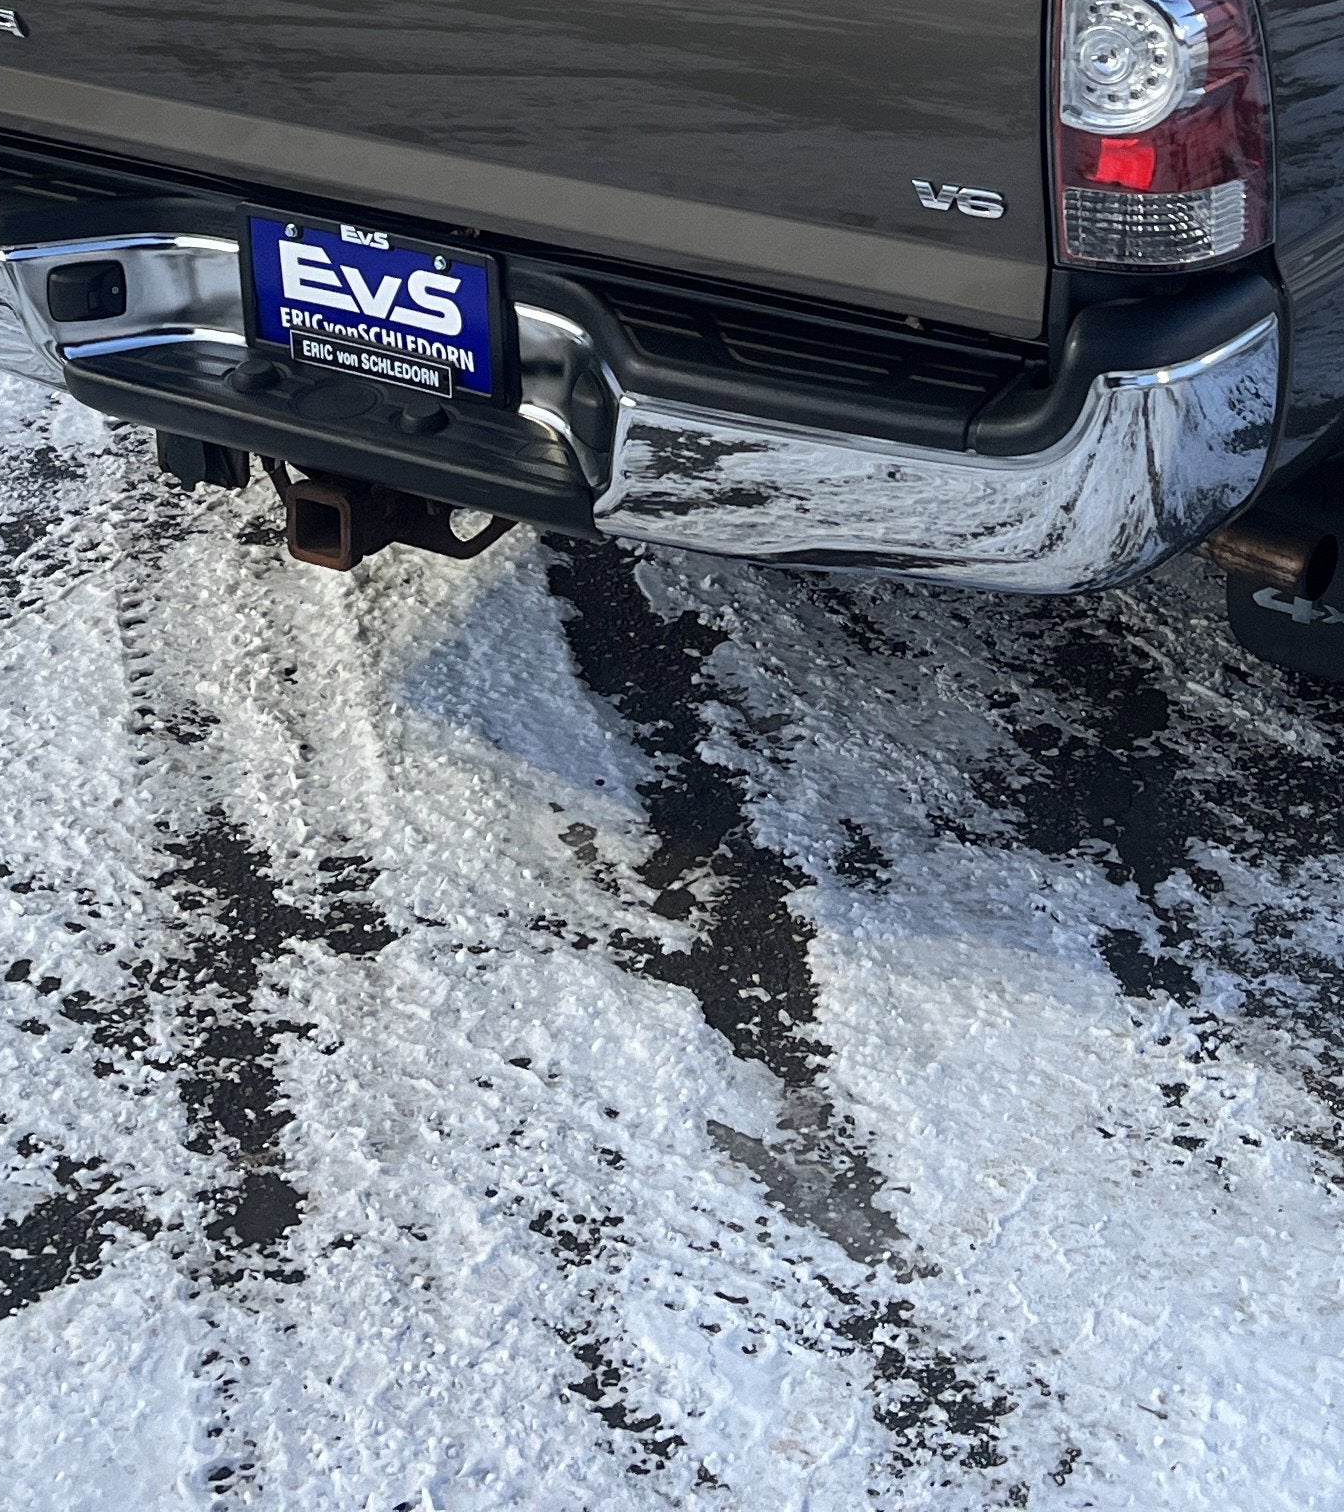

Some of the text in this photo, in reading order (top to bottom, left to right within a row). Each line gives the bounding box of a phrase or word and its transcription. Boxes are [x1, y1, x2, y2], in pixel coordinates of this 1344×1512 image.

[911, 179, 1005, 220] V6
[302, 340, 440, 388] ERIC von SCHLEDORN
